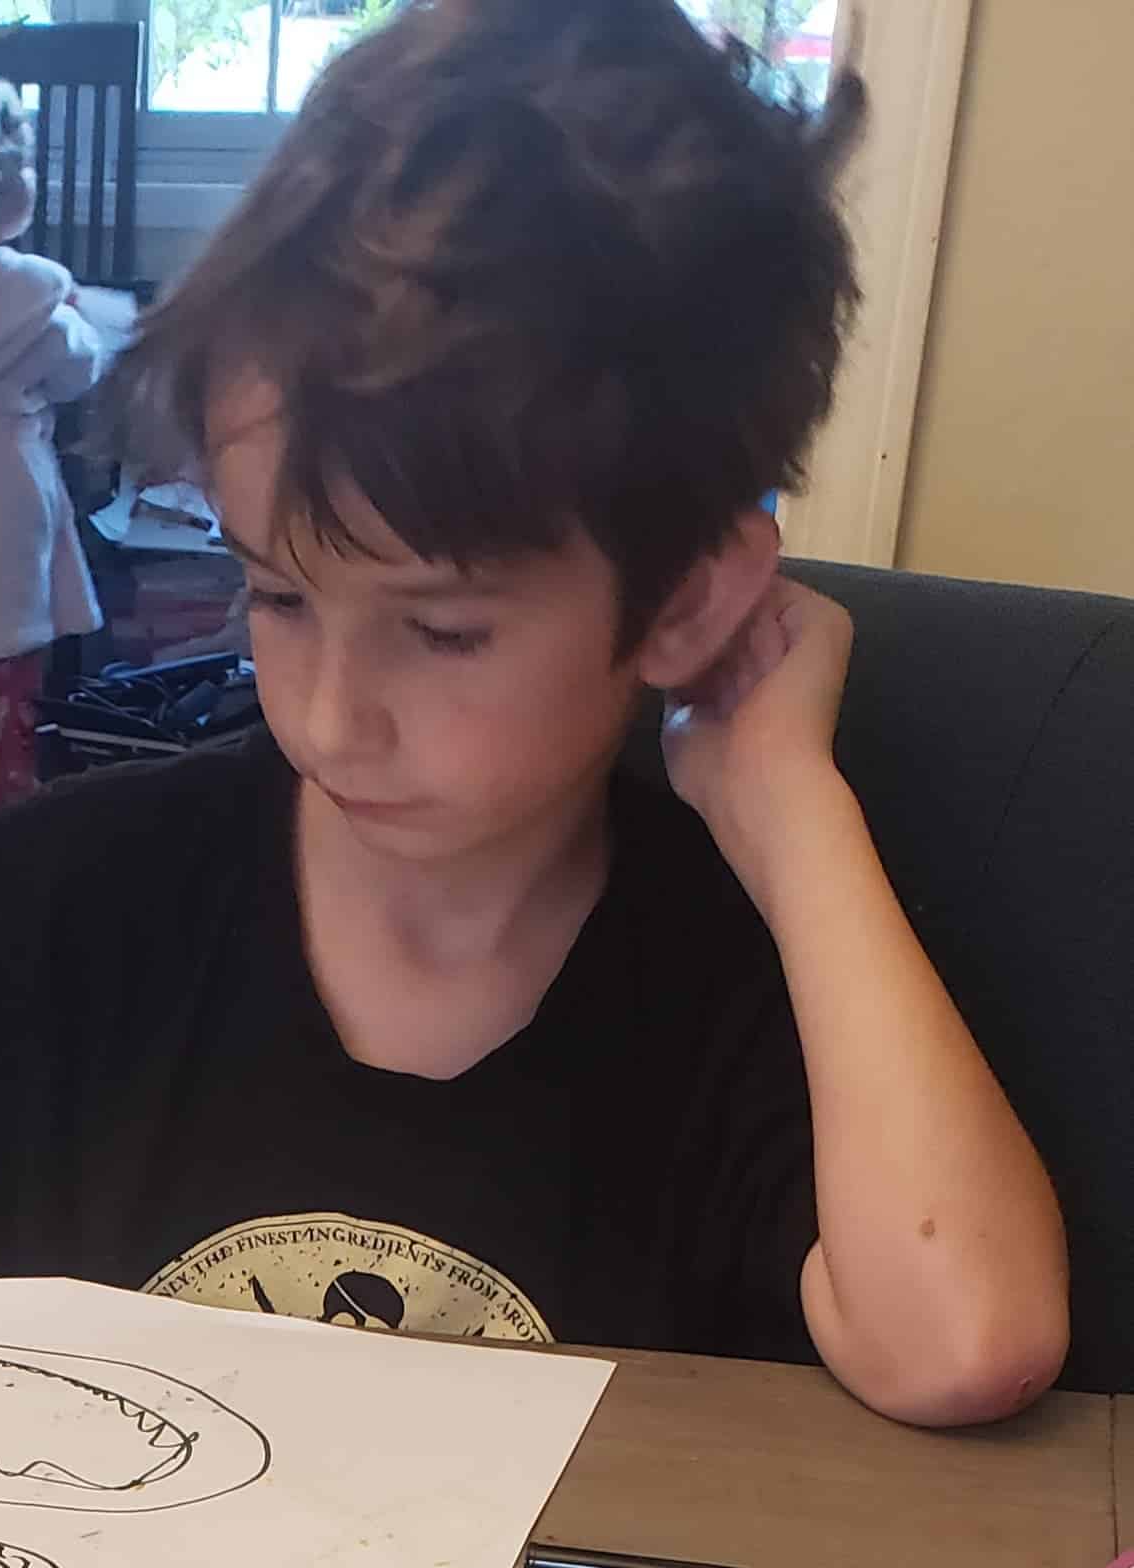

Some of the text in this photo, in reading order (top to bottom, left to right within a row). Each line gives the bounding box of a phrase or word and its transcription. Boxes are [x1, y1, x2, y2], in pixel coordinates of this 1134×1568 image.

[191, 1246, 233, 1274] THE
[236, 1230, 301, 1252] FINEST
[306, 1227, 446, 1272] INGREDIENTS
[448, 1266, 498, 1301] FROM
[497, 1302, 535, 1340] ARO
